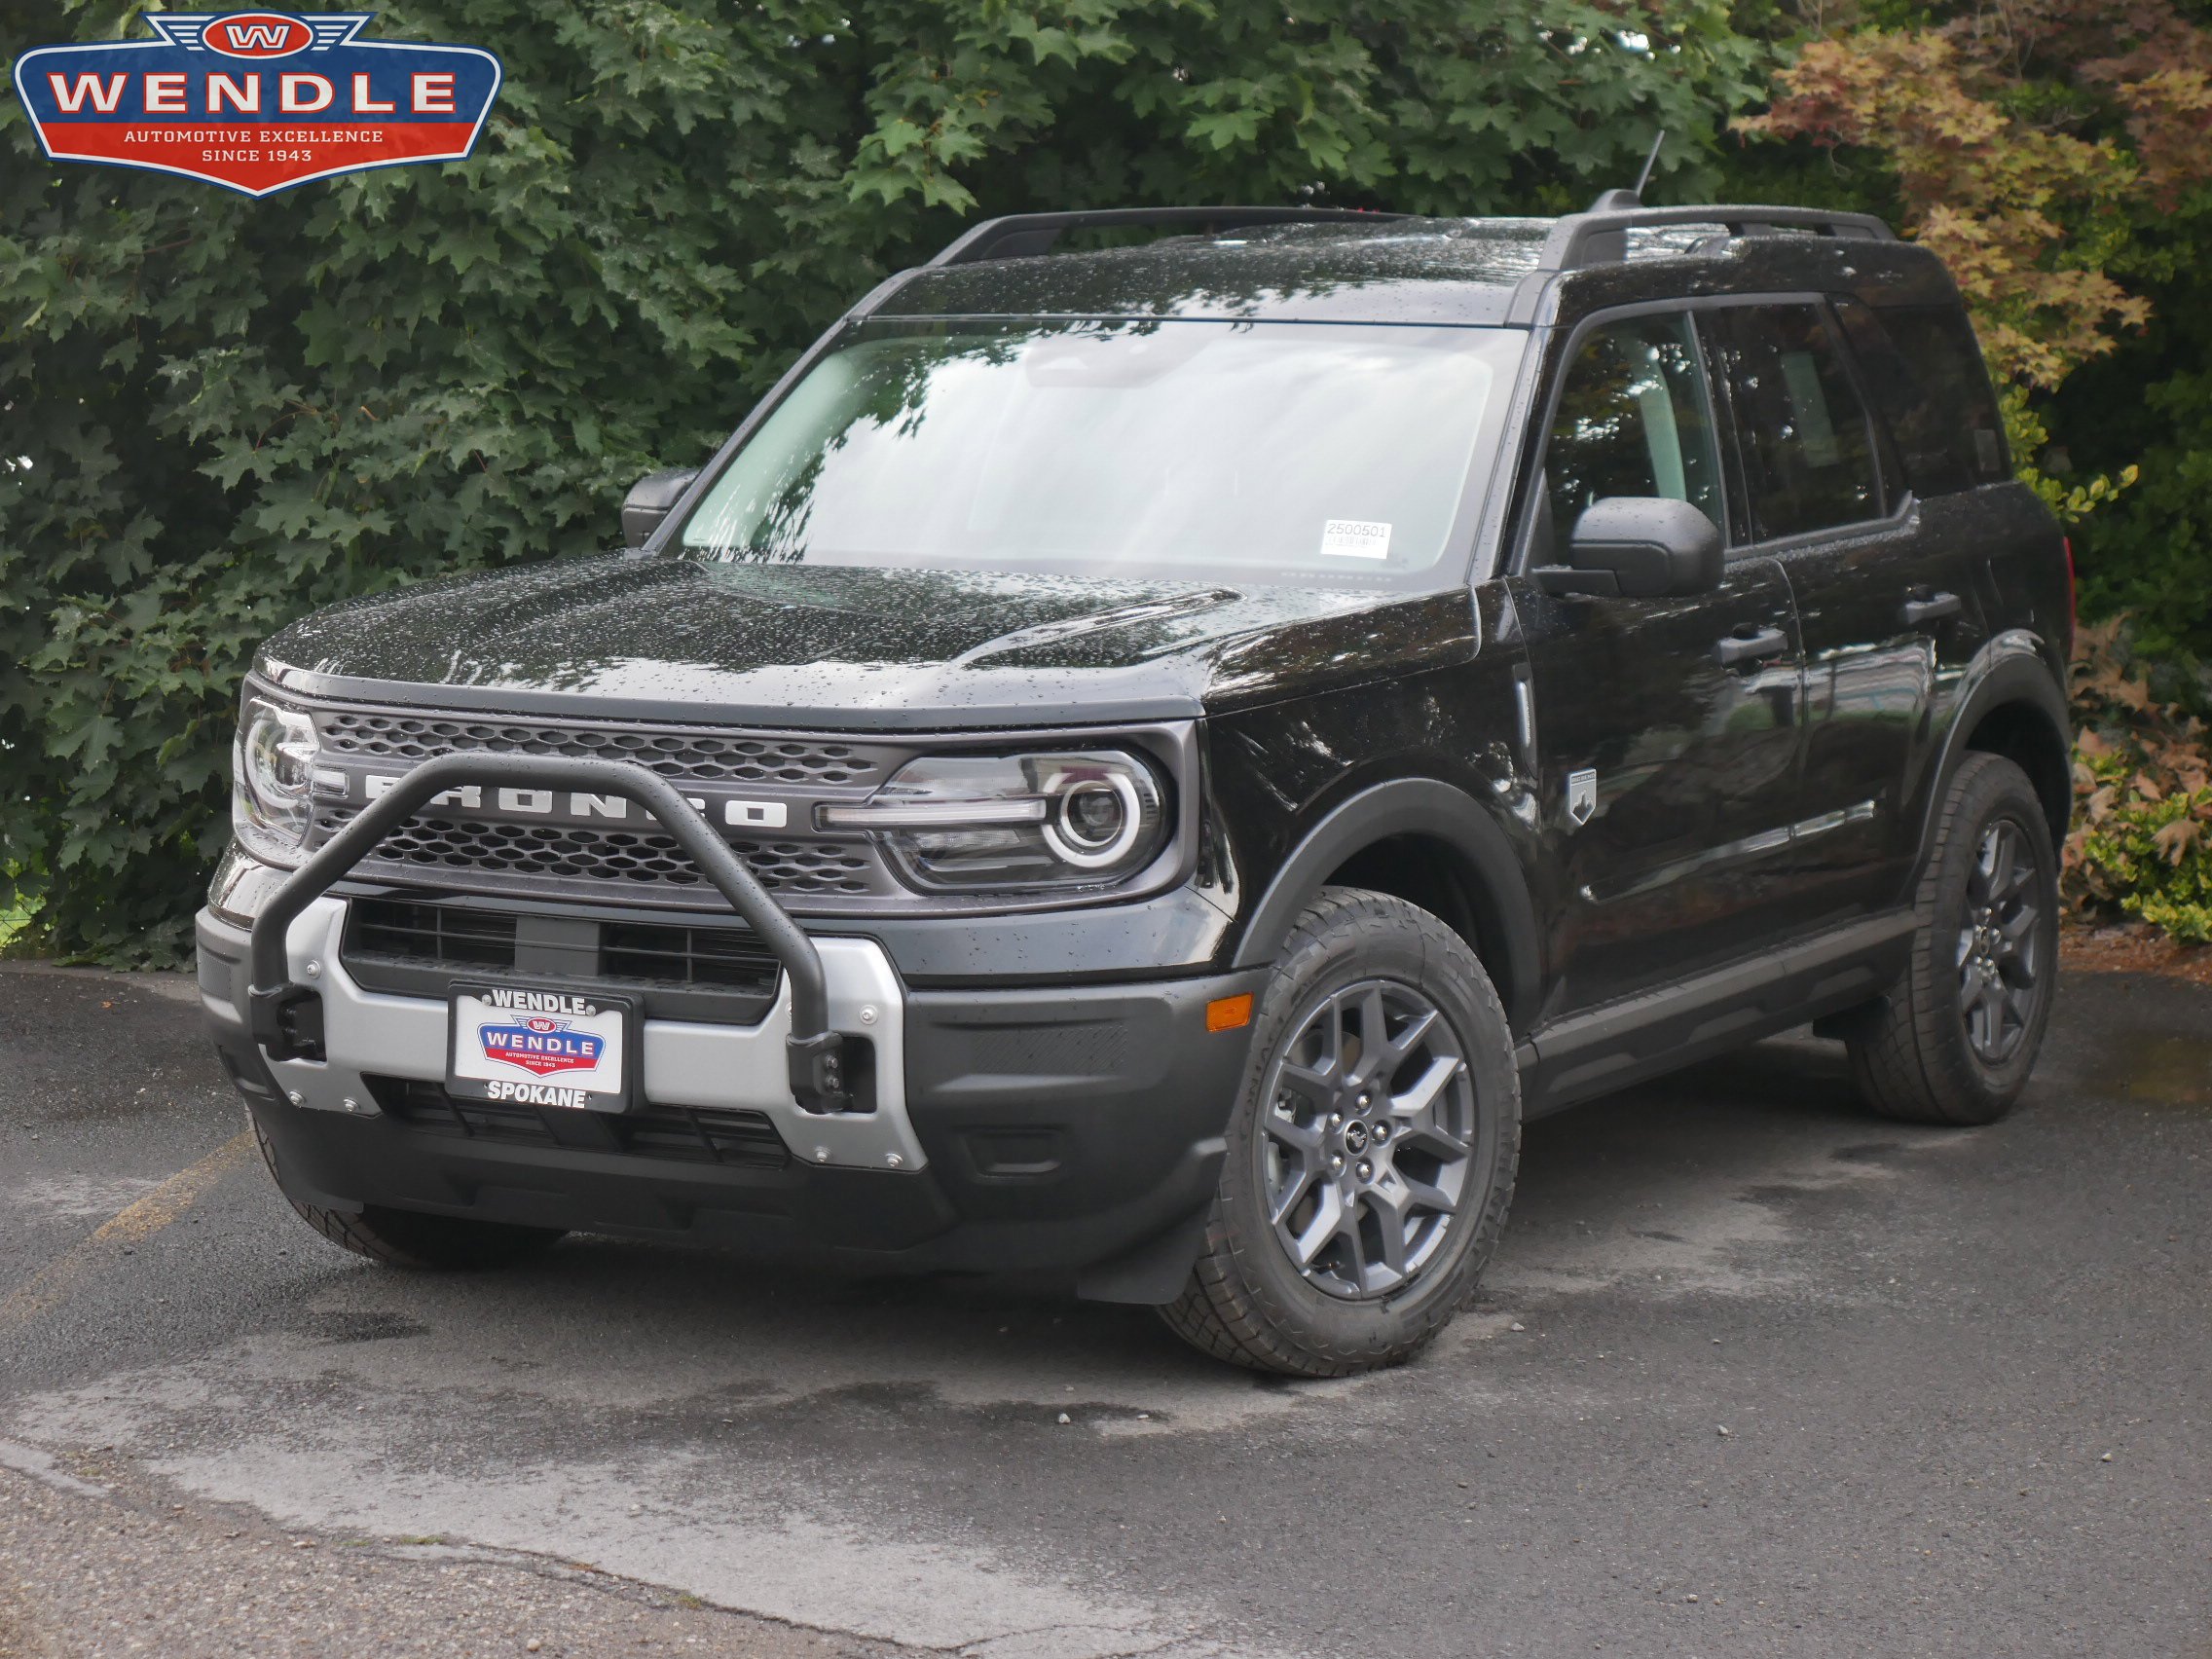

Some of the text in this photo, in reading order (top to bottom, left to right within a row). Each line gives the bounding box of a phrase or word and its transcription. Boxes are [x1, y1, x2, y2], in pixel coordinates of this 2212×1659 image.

[1327, 523, 1386, 537] 2500501
[492, 989, 586, 1015] WENDLE
[487, 1032, 594, 1055] WENDLE
[505, 1051, 574, 1064] AUTOMOTIVE EXCELLENCE
[488, 1080, 586, 1109] SPOKANE
